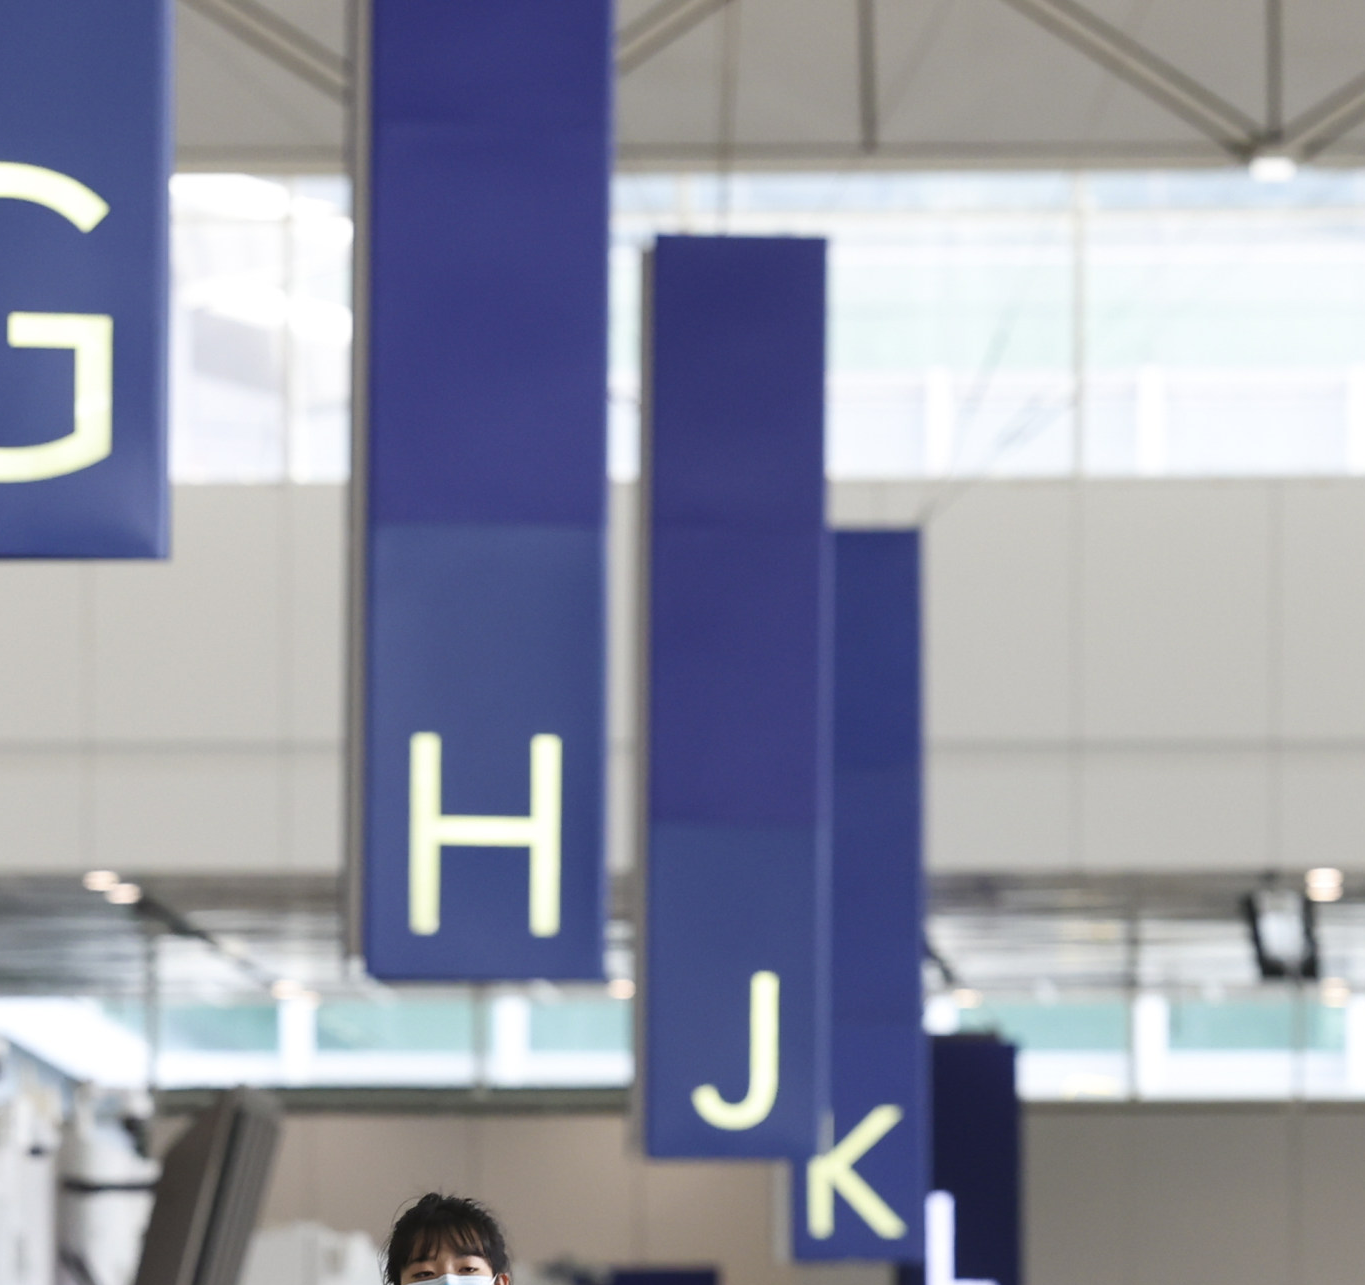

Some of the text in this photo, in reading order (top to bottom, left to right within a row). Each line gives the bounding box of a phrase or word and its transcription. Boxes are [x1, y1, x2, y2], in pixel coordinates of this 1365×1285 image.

[408, 730, 564, 939] H
[691, 969, 781, 1131] J
[806, 1104, 906, 1240] K
